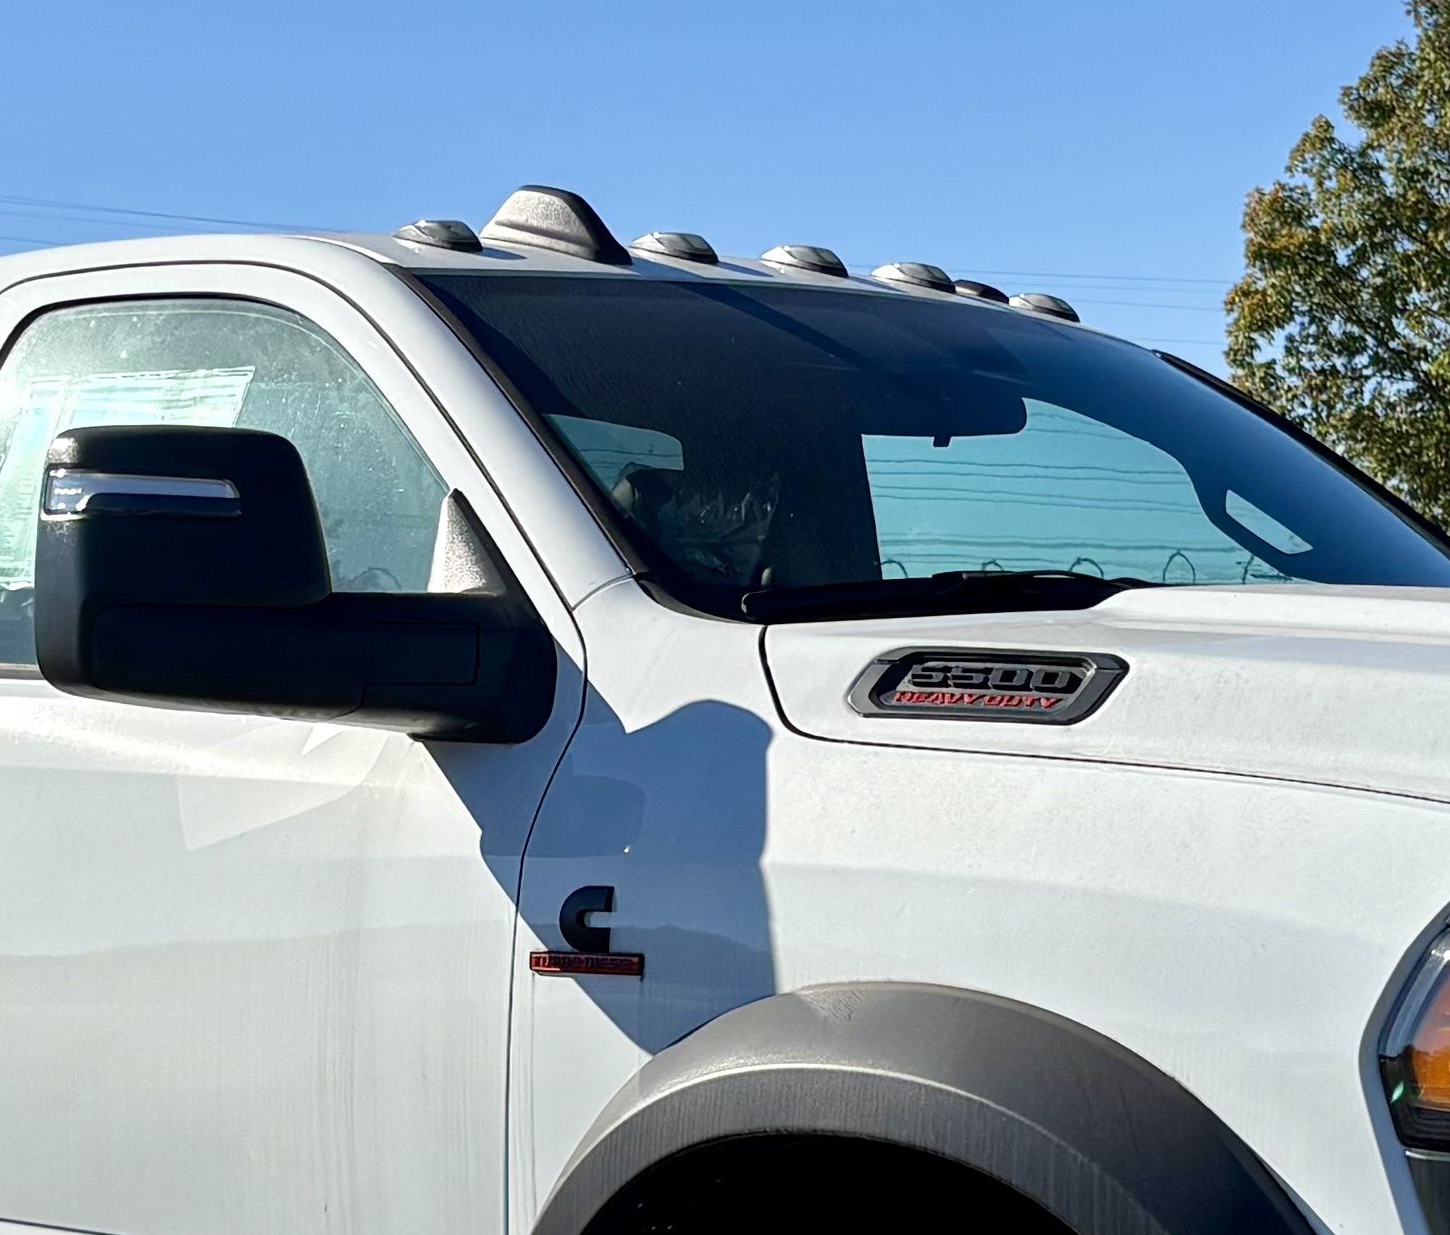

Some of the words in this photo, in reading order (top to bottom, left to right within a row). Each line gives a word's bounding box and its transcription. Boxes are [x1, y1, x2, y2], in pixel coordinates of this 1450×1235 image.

[911, 664, 1076, 693] 5500
[894, 690, 980, 706] HEAVY
[982, 693, 1062, 709] DUTY
